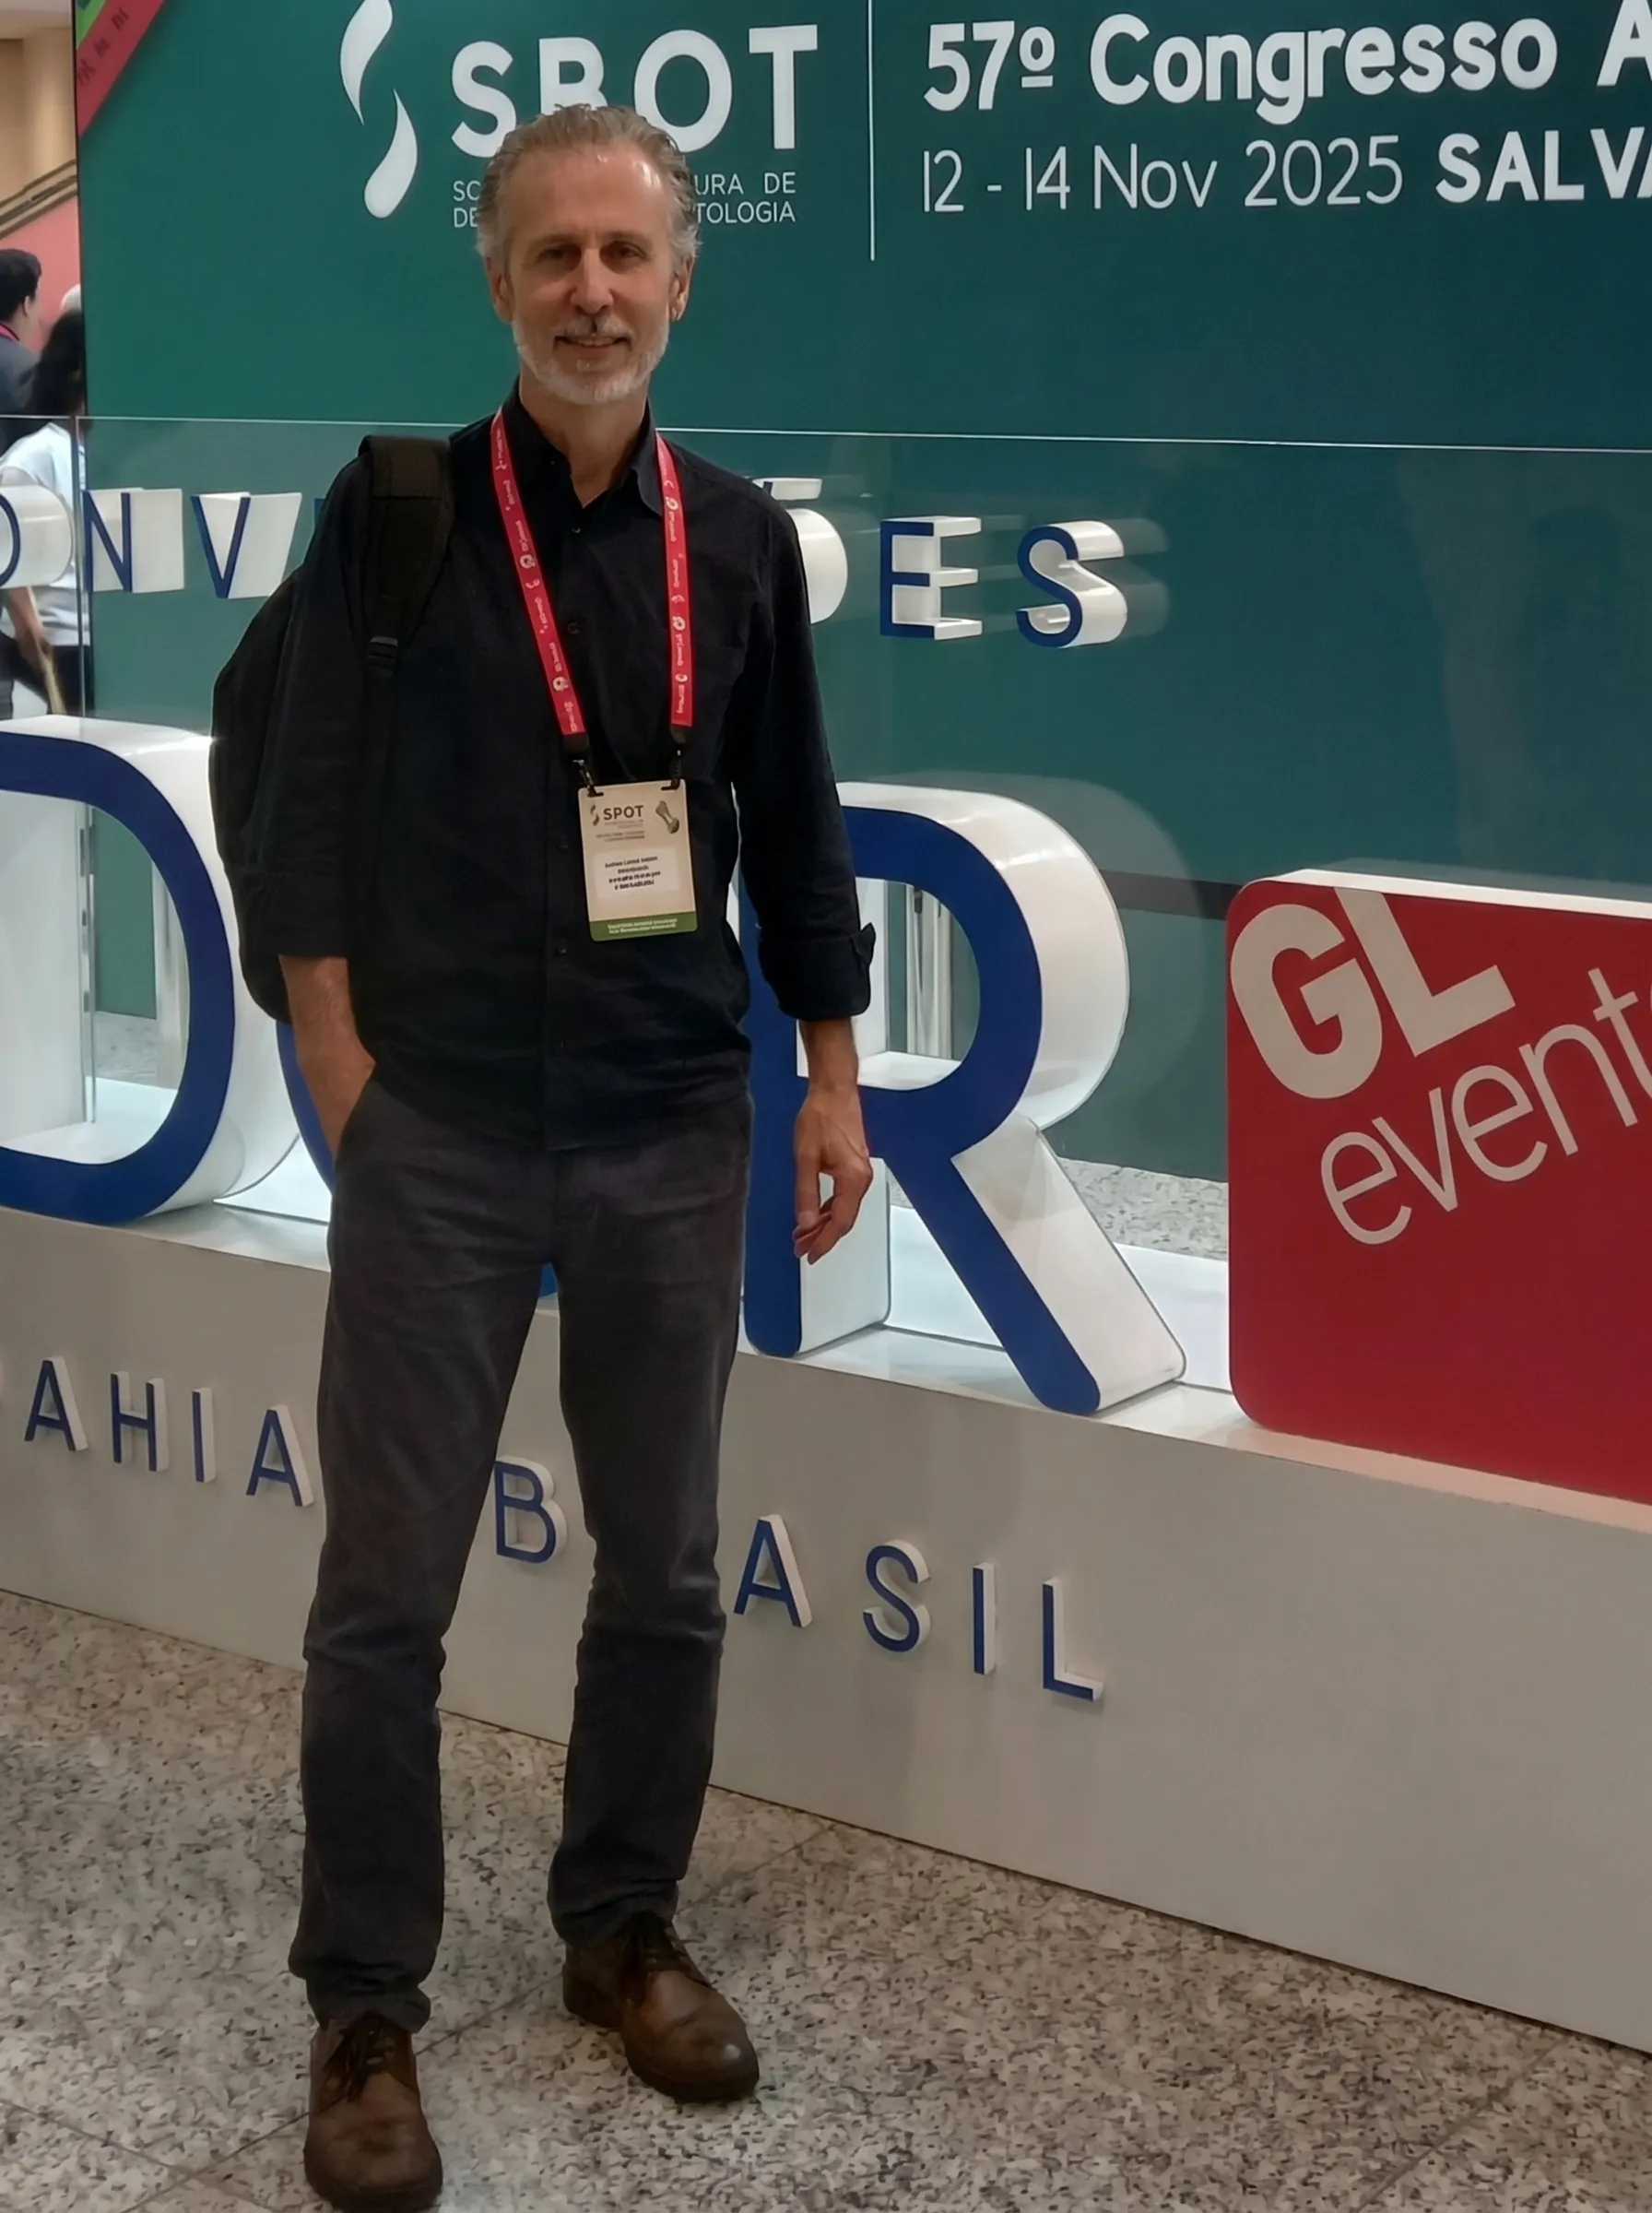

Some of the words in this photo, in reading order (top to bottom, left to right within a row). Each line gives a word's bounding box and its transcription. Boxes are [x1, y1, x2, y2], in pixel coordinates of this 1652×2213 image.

[1090, 13, 1559, 126] Congresso
[696, 201, 796, 224] TOLOGIA
[764, 172, 796, 194] DE
[923, 148, 964, 213] 12
[1025, 146, 1071, 211] 14
[1093, 143, 1218, 210] Nov
[1245, 135, 1404, 207] 2025
[603, 805, 643, 821] SPOT
[1230, 886, 1516, 1100] GL
[1320, 967, 1652, 1245] event
[494, 1456, 1105, 1702] BASIL
